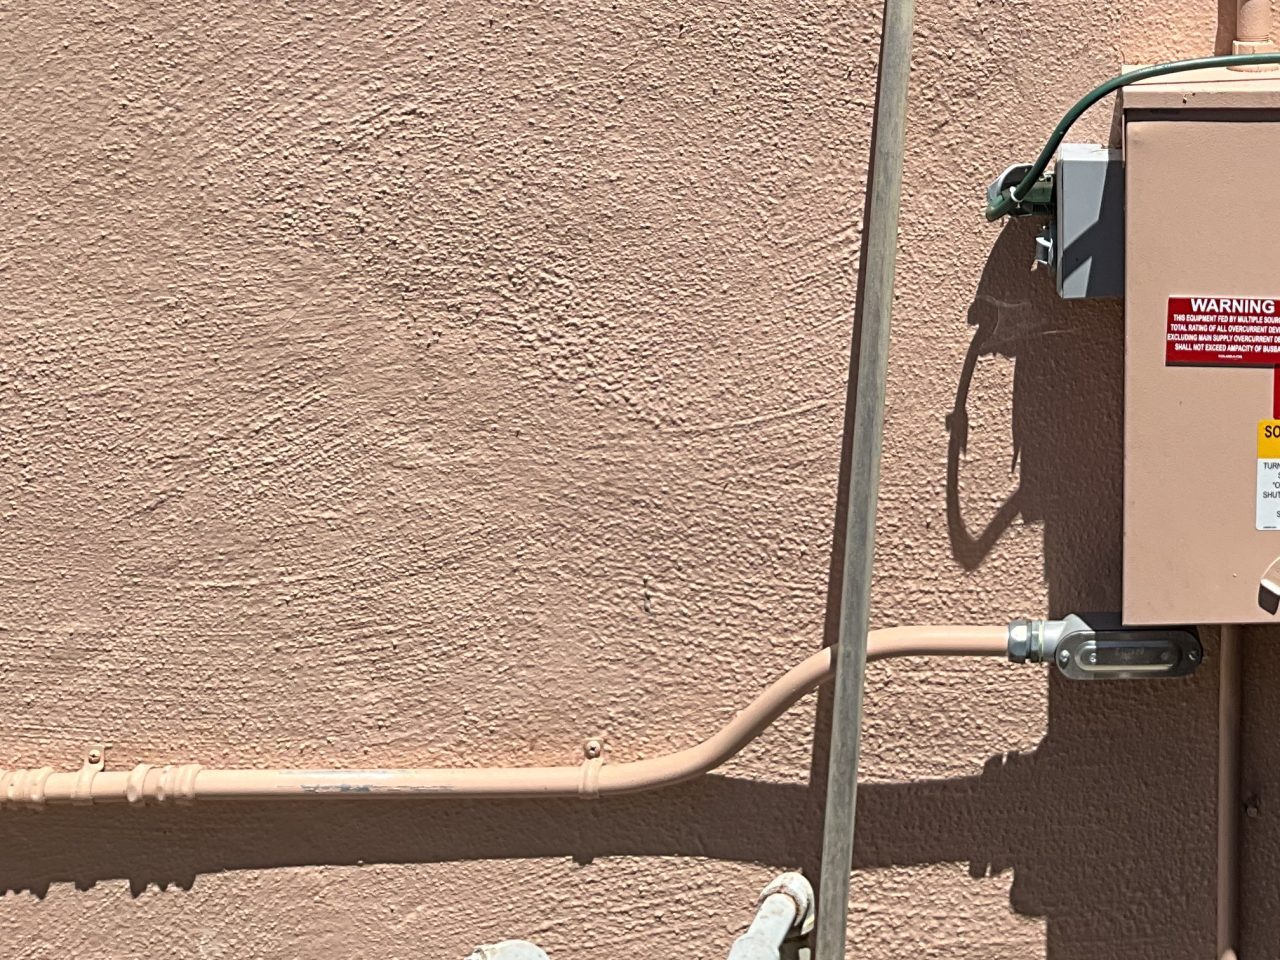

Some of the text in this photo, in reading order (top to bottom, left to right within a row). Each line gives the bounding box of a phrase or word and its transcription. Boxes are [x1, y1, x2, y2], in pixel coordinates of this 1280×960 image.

[1190, 298, 1275, 314] WARNING
[1173, 314, 1185, 322] THIS
[1186, 314, 1217, 322] EQUIPMENT
[1218, 315, 1229, 323] FED
[1188, 324, 1208, 332] RATING
[1228, 325, 1268, 333] OVERCURRENT
[1234, 335, 1273, 343] OVERCURRENT
[1175, 343, 1192, 351] SHALL
[1205, 344, 1226, 352] EXCEED
[1227, 344, 1254, 353] AMPACITY
